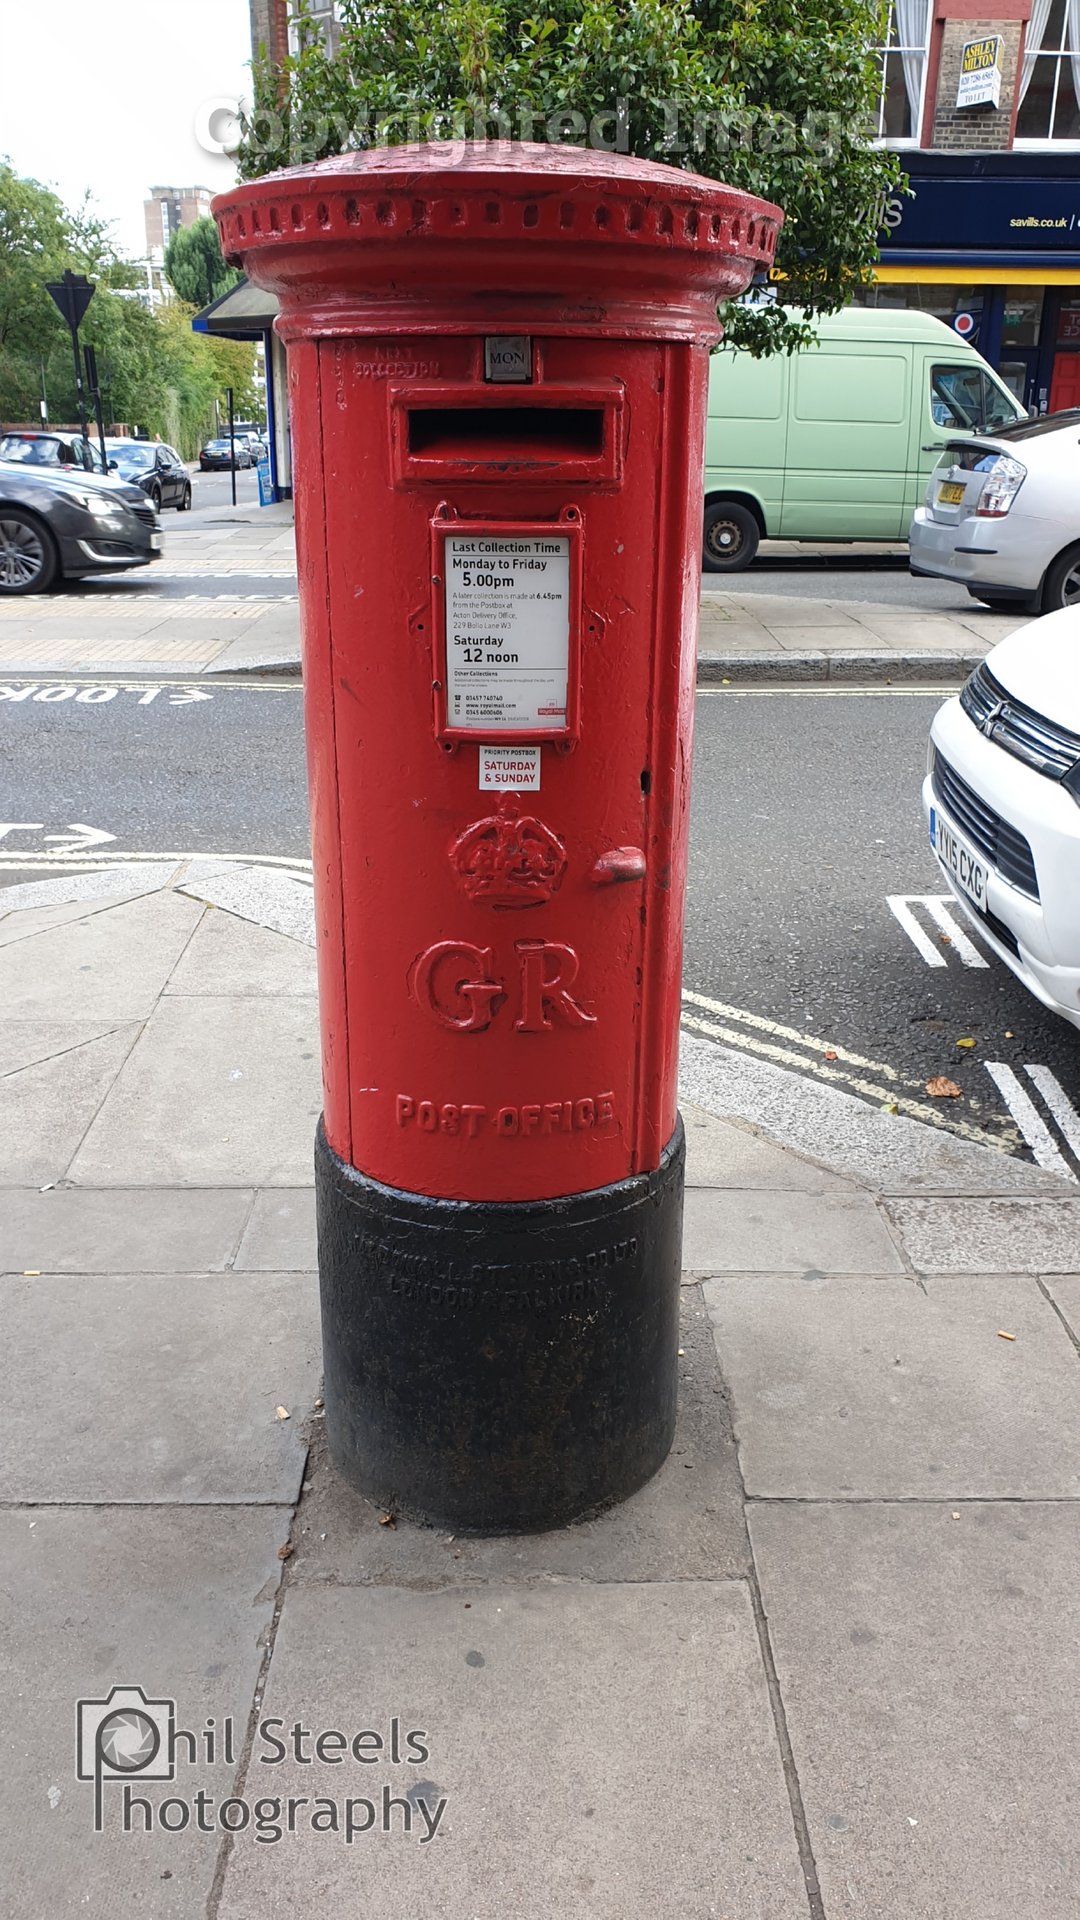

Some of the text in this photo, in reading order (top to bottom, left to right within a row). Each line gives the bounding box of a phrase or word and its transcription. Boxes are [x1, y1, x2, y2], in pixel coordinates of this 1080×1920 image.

[965, 40, 997, 58] ASHLEY
[963, 53, 995, 71] MILTON
[965, 92, 985, 104] TO LET
[1009, 216, 1068, 228] savills.co.uk
[490, 352, 525, 364] MON
[452, 542, 561, 553] Last Collection Time
[452, 559, 547, 571] Monday to Friday
[463, 572, 514, 589] 5.00pm
[536, 592, 562, 600] 6.45pm
[452, 601, 469, 609] from
[469, 601, 480, 609] the
[453, 611, 471, 619] Acton
[472, 612, 497, 620] Delivery
[453, 635, 504, 648] Saturday
[463, 649, 519, 663] 12 noon
[0, 686, 162, 705] LOOK
[484, 761, 537, 771] SATURDAY
[484, 773, 536, 783] & SUNDAY
[959, 849, 984, 900] CXG
[396, 1091, 615, 1138] POST OFFICE
